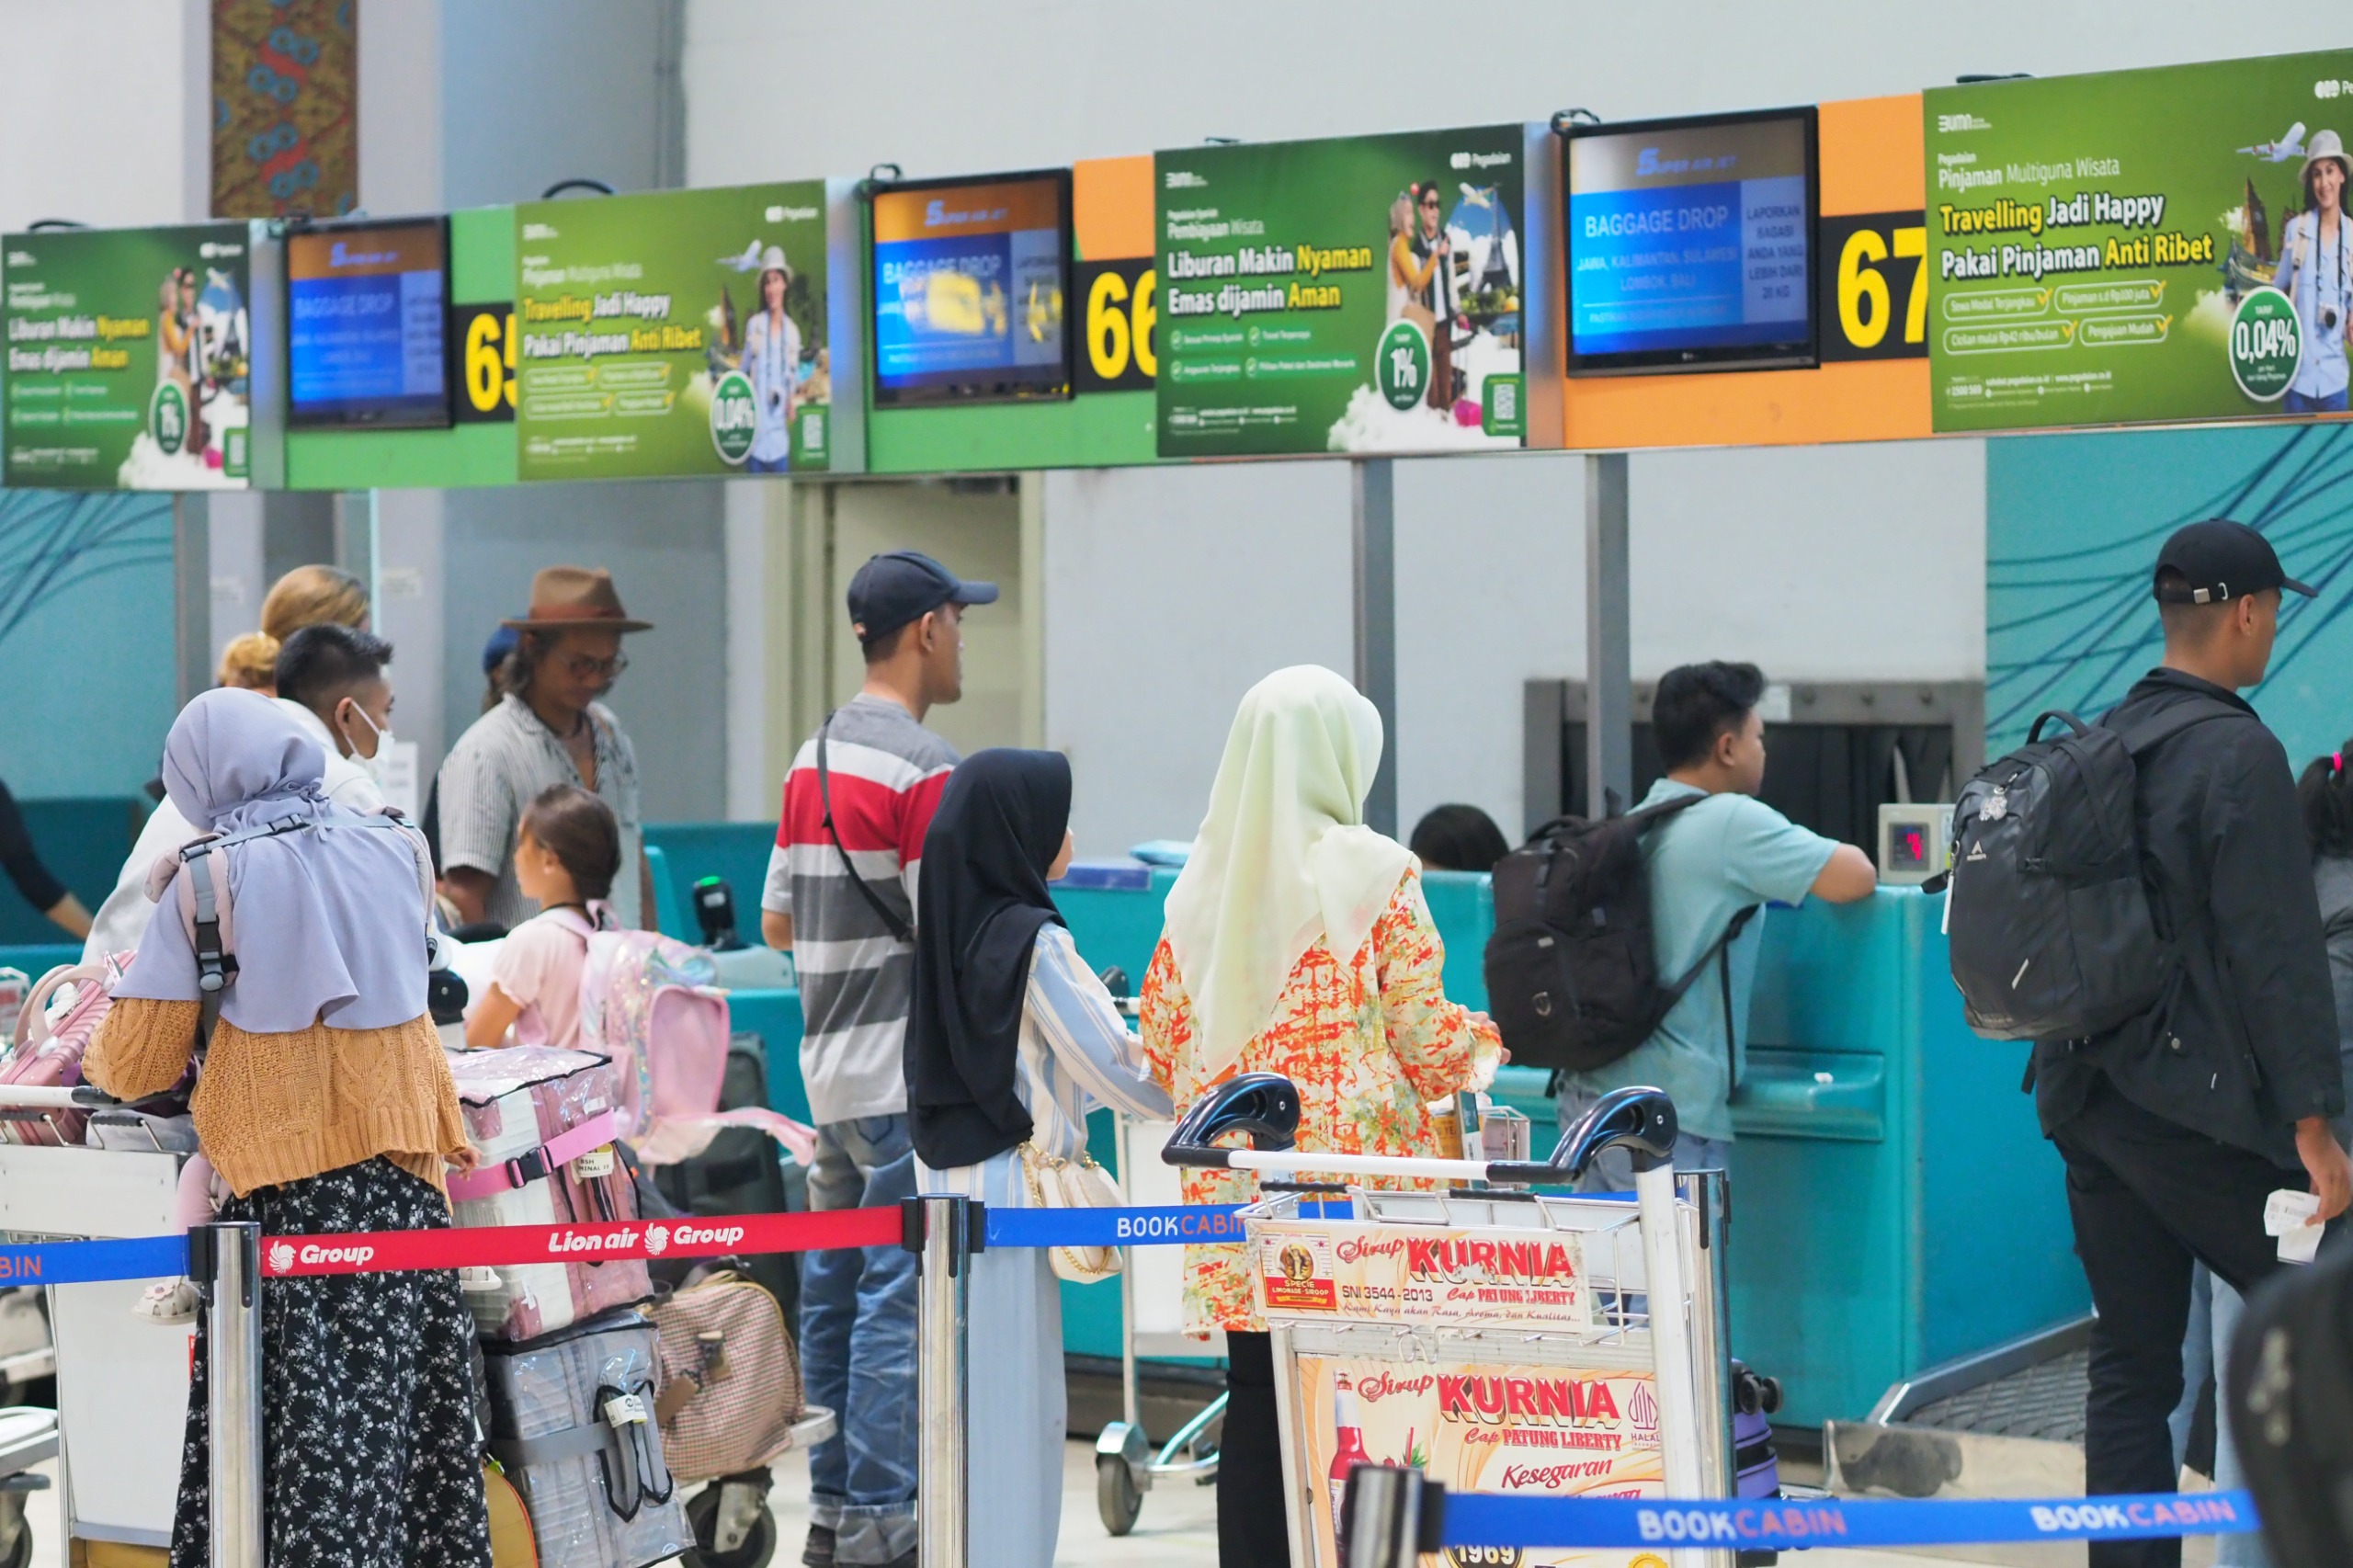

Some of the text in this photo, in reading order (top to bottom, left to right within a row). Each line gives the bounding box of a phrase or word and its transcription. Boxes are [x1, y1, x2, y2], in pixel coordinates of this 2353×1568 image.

[1938, 157, 2120, 193] Pinjaman Multiguna Wisata
[1585, 205, 1729, 238] BAGGAGE DROP
[1939, 191, 2165, 233] Travelling Jadi Happy
[1167, 244, 1372, 279] Liburan Makin Nyaman
[1940, 232, 2213, 280] Pakai Pinjaman Anti Ribet
[1167, 281, 1341, 318] Emas dijamin Aman
[1838, 226, 1928, 348] 67
[523, 290, 672, 324] Travelling Jadi Happy
[523, 324, 702, 360] Pakai Pinjaman Anti Ribet
[2235, 317, 2296, 365] 0,04%
[1390, 347, 1417, 388] 1%
[300, 1243, 374, 1266] Group
[548, 1225, 745, 1253] Lion air Group
[1336, 1235, 1577, 1288] Sirup KURNIA
[1284, 1279, 1315, 1289] SPECIE
[1342, 1285, 1362, 1299] SNI
[1447, 1288, 1477, 1302] Cap
[1342, 1301, 1371, 1313] Kami
[1373, 1302, 1402, 1316] Kaya
[1404, 1306, 1428, 1316] akan
[1431, 1306, 1462, 1318] Rasa,
[1505, 1308, 1524, 1320] dan
[1358, 1370, 1622, 1430] Sirup KURNIA
[1463, 1427, 1622, 1451] Cap PATUNG LIBERTY
[1631, 1432, 1661, 1442] HALAL
[1501, 1459, 1612, 1489] Kesegaran
[1636, 1509, 1847, 1540] BOOKCABIN
[2029, 1499, 2236, 1531] BOOKCABIN
[1458, 1545, 1516, 1562] 1969
